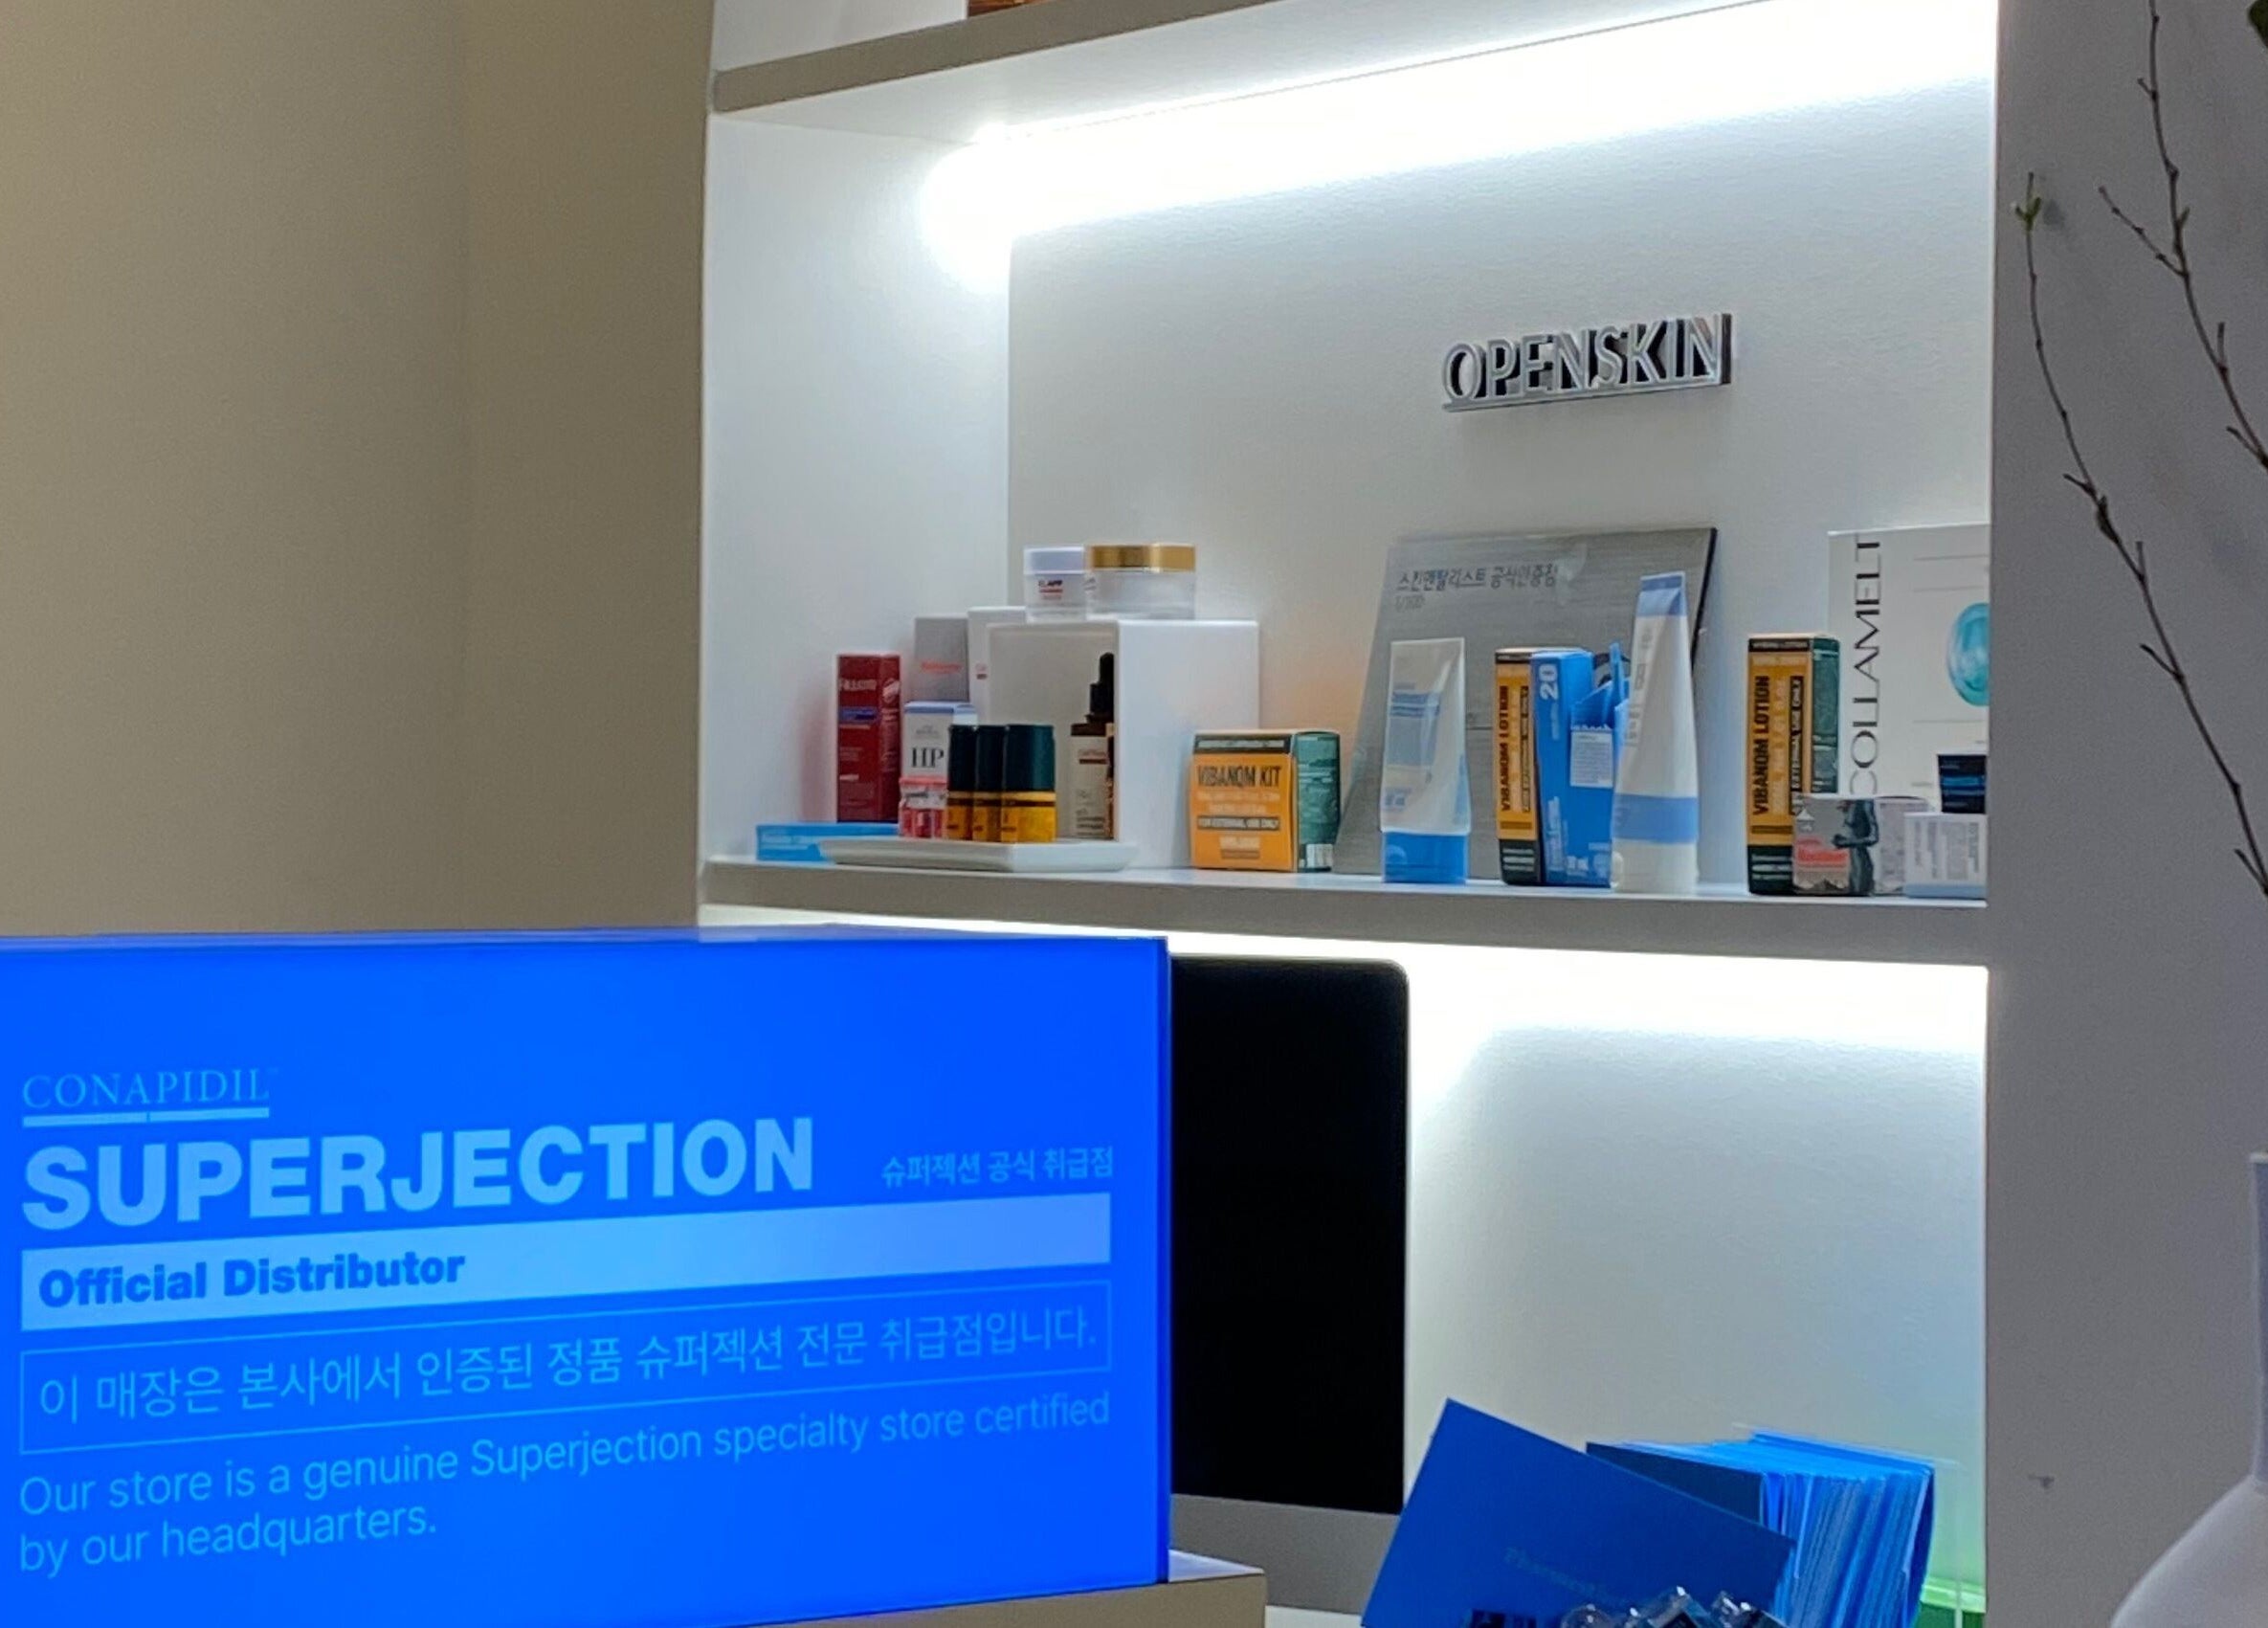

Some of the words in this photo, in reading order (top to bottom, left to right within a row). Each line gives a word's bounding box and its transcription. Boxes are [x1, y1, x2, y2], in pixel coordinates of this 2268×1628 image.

[1441, 313, 1731, 406] OPENSKIN
[1539, 664, 1559, 701] 20
[1754, 676, 1769, 734] LOTION
[1259, 765, 1282, 787] KIT
[22, 1067, 270, 1108] CONAPIDIL
[21, 1117, 813, 1231] SUPERJECTION
[880, 1151, 982, 1189] 슈퍼젝션
[988, 1148, 1036, 1183] 공식
[1042, 1145, 1115, 1180] 취급점
[38, 1261, 208, 1308] Official
[223, 1251, 466, 1297] Distributor
[39, 1374, 79, 1424] 이
[97, 1366, 226, 1419] 매장은
[237, 1350, 402, 1409] 본사에서
[415, 1341, 534, 1397] 인증된
[547, 1337, 624, 1386] 정품
[635, 1325, 784, 1381] 슈퍼젝션
[796, 1320, 868, 1369] 전문
[878, 1305, 1097, 1363] 취급점입니다.
[19, 1476, 95, 1515] Our
[108, 1468, 212, 1508] store
[224, 1460, 256, 1498] is
[268, 1463, 290, 1494] a
[302, 1443, 459, 1501] genuine
[470, 1428, 702, 1482] Superjection
[713, 1411, 869, 1463] specialty
[879, 1403, 966, 1443] store
[974, 1391, 1110, 1434] certified
[19, 1535, 69, 1579] by
[81, 1530, 149, 1567] our
[161, 1502, 437, 1557] headquarters.
